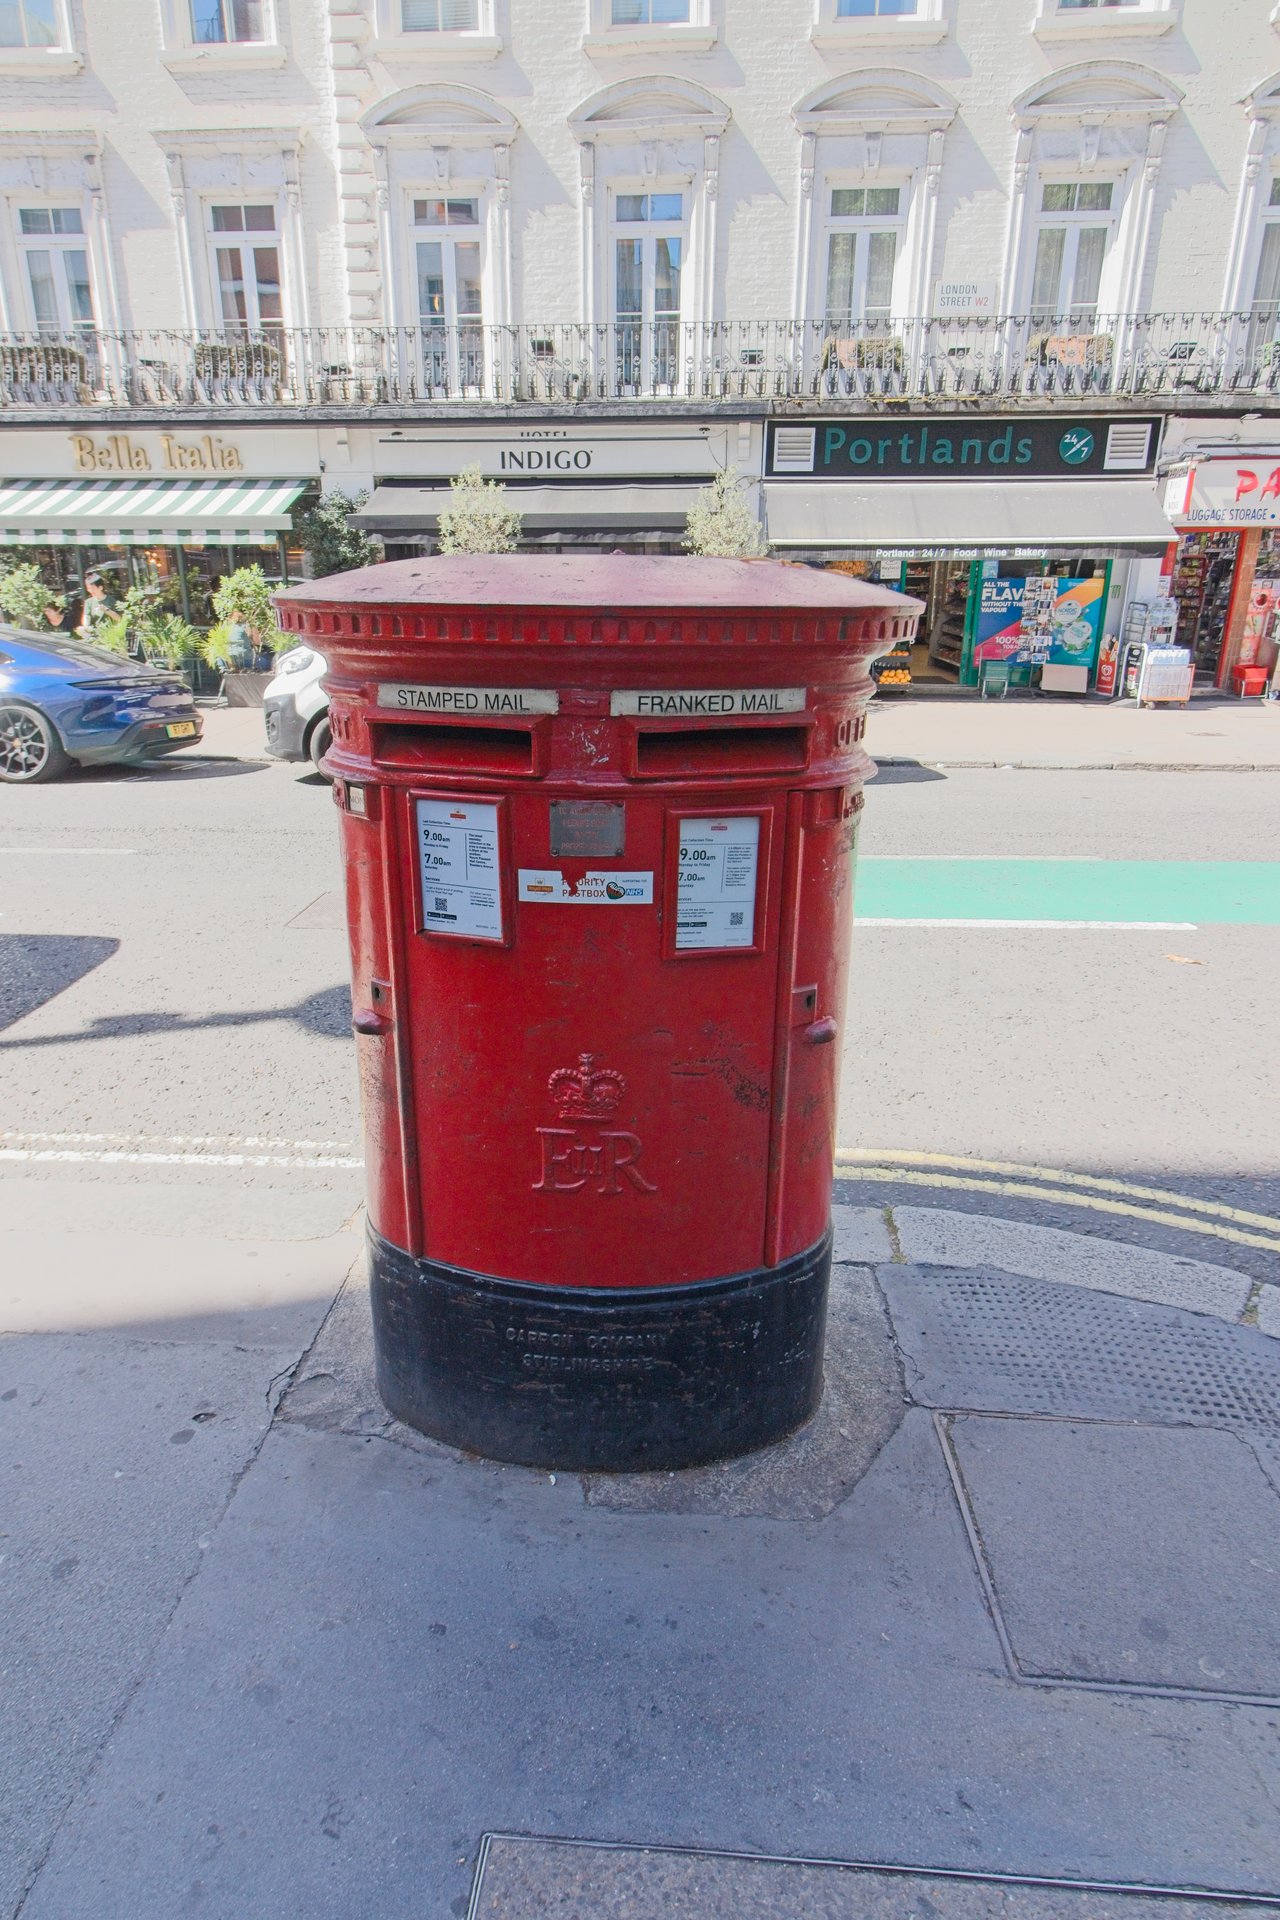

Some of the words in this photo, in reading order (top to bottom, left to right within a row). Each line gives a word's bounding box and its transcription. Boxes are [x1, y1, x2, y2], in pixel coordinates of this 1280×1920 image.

[940, 285, 978, 294] LONDON
[940, 296, 972, 306] STREET
[975, 296, 989, 306] W2
[823, 426, 1033, 465] Portlands
[69, 434, 152, 472] Bella
[160, 434, 243, 472] Italia
[500, 450, 592, 469] INDIGO
[1187, 509, 1227, 521] LUGGAGE
[1229, 508, 1268, 520] STORAGE
[876, 549, 915, 558] Portland
[953, 548, 977, 557] Food
[984, 548, 1007, 557] Wine
[1014, 547, 1047, 560] Bakery
[396, 689, 479, 710] STAMPED
[483, 693, 531, 712] MAIL
[637, 694, 736, 713] FRANKED
[740, 693, 784, 712] MAIL
[423, 829, 451, 843] 9.00am
[424, 853, 452, 867] 7.00am
[680, 848, 716, 861] 9.00am
[561, 878, 606, 886] PORITY
[678, 872, 705, 882] 7.00am
[561, 889, 606, 897] PSTBOX
